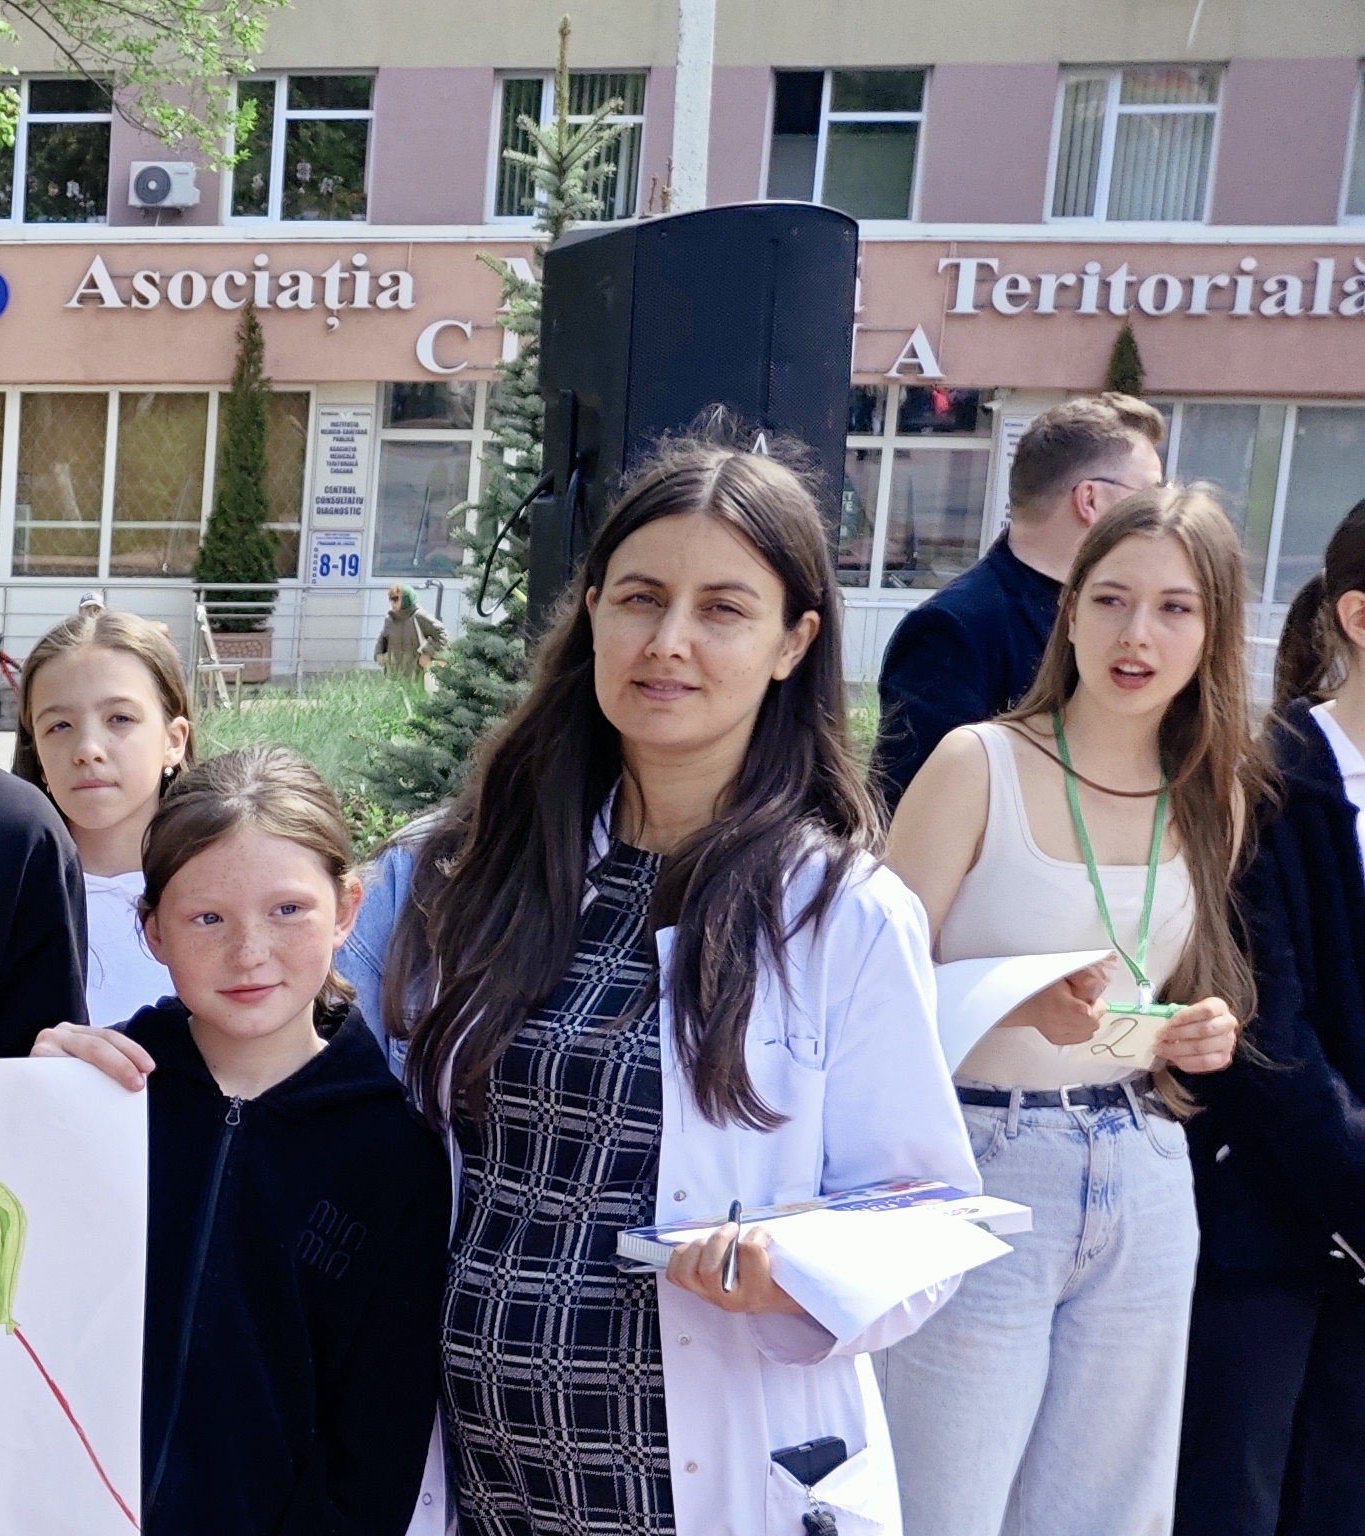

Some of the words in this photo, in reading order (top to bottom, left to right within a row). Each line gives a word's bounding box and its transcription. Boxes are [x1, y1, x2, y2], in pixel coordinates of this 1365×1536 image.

[64, 252, 417, 333] Asociația
[324, 485, 356, 494] CENTRUL
[315, 495, 364, 505] CONSULTATIV
[316, 506, 362, 515] DIAGNOSTIC
[319, 553, 360, 577] 8-19
[1089, 1017, 1139, 1059] 2
